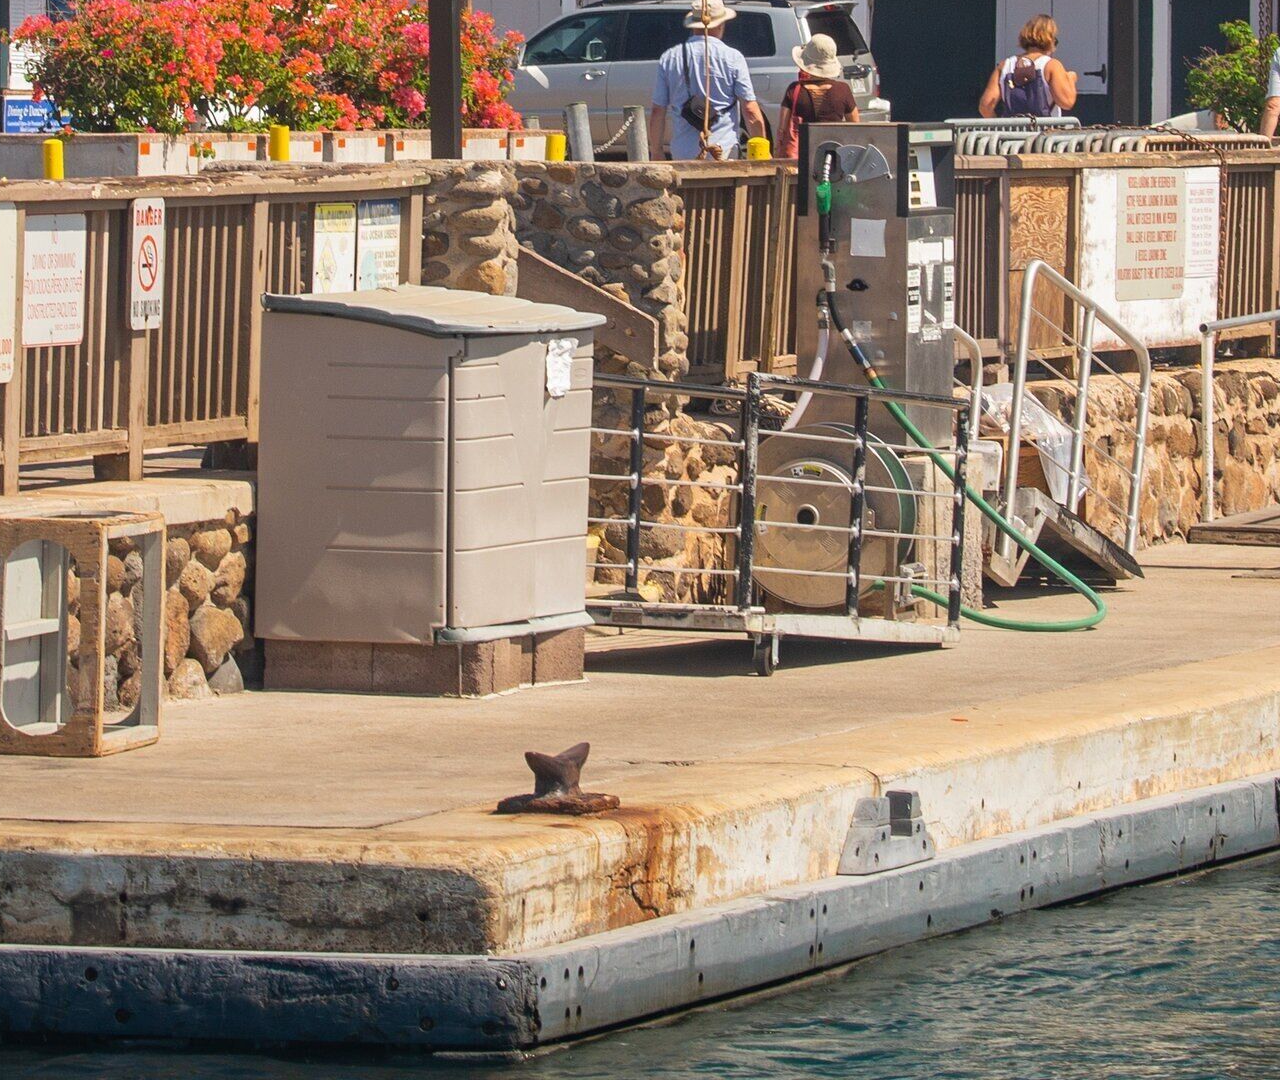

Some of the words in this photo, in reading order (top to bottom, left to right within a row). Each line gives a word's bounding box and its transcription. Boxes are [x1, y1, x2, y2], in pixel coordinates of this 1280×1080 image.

[136, 209, 162, 226] DANGER
[133, 300, 139, 317] NO
[140, 300, 161, 316] SMOKING
